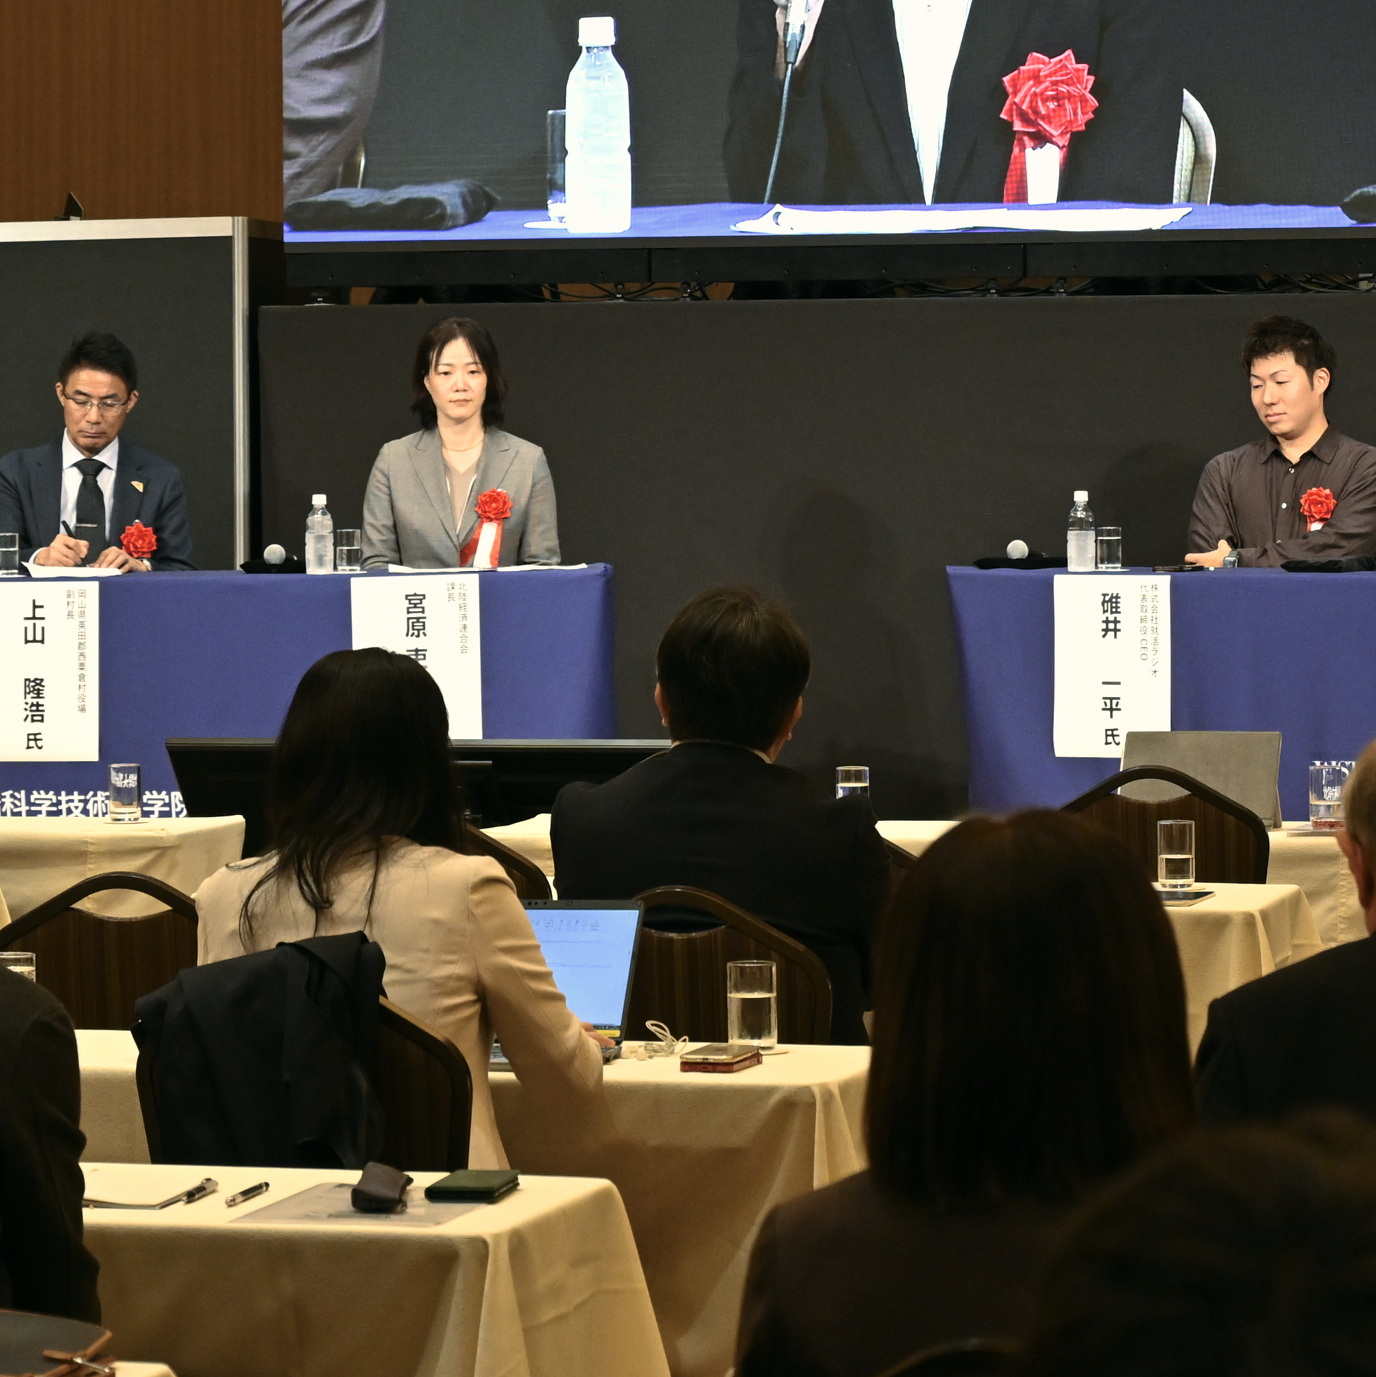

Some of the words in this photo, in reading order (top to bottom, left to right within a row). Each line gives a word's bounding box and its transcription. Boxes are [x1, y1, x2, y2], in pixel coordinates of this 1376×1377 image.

[23, 599, 46, 645] 上山
[405, 592, 427, 638] 宮原
[1101, 592, 1122, 639] 碓井
[1140, 638, 1148, 661] CEO
[23, 677, 46, 723] 隆浩
[1101, 680, 1122, 719] 一平
[25, 732, 44, 750] 氏
[1104, 728, 1121, 746] 氏
